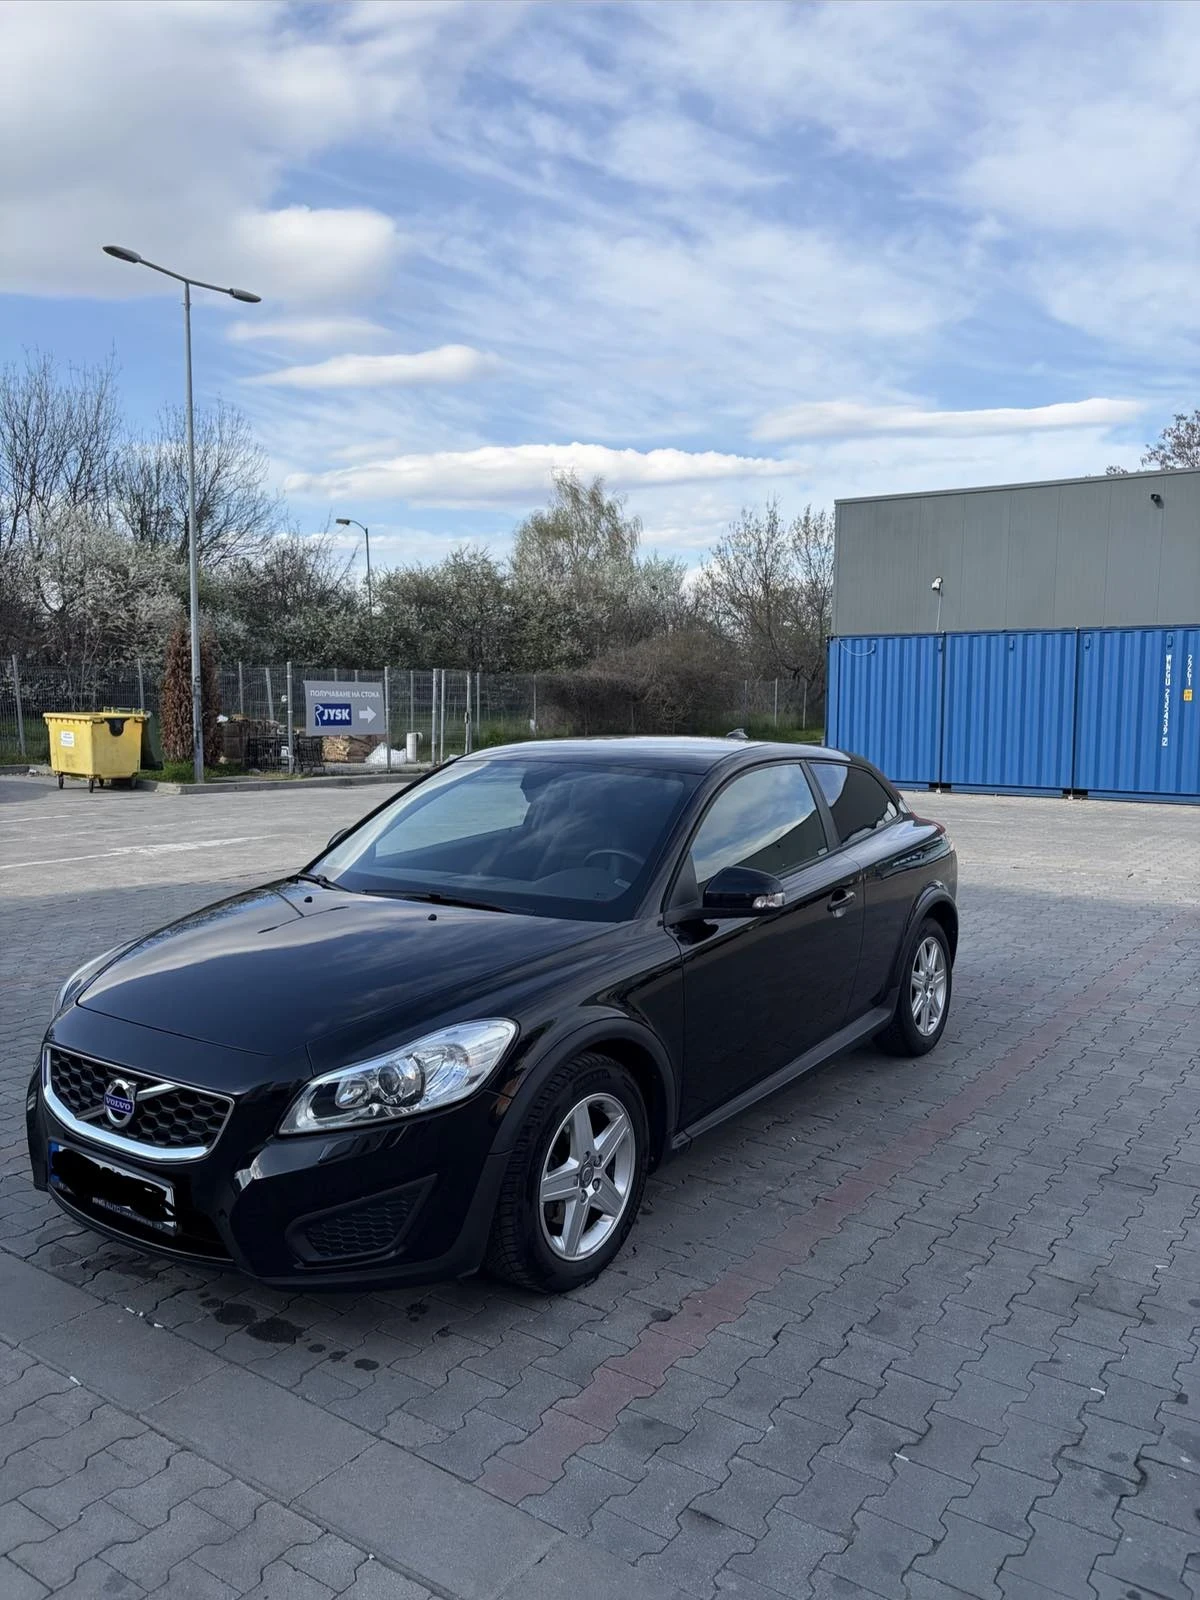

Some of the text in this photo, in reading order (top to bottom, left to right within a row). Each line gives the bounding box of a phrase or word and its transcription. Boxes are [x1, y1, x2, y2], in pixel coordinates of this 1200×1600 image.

[310, 689, 380, 698] ПОЛУЧАВАНЕ НА СТОКА
[322, 709, 350, 720] JYSK
[1162, 737, 1168, 746] 2
[105, 1096, 131, 1110] VOLVO
[106, 1201, 121, 1213] AUTO
